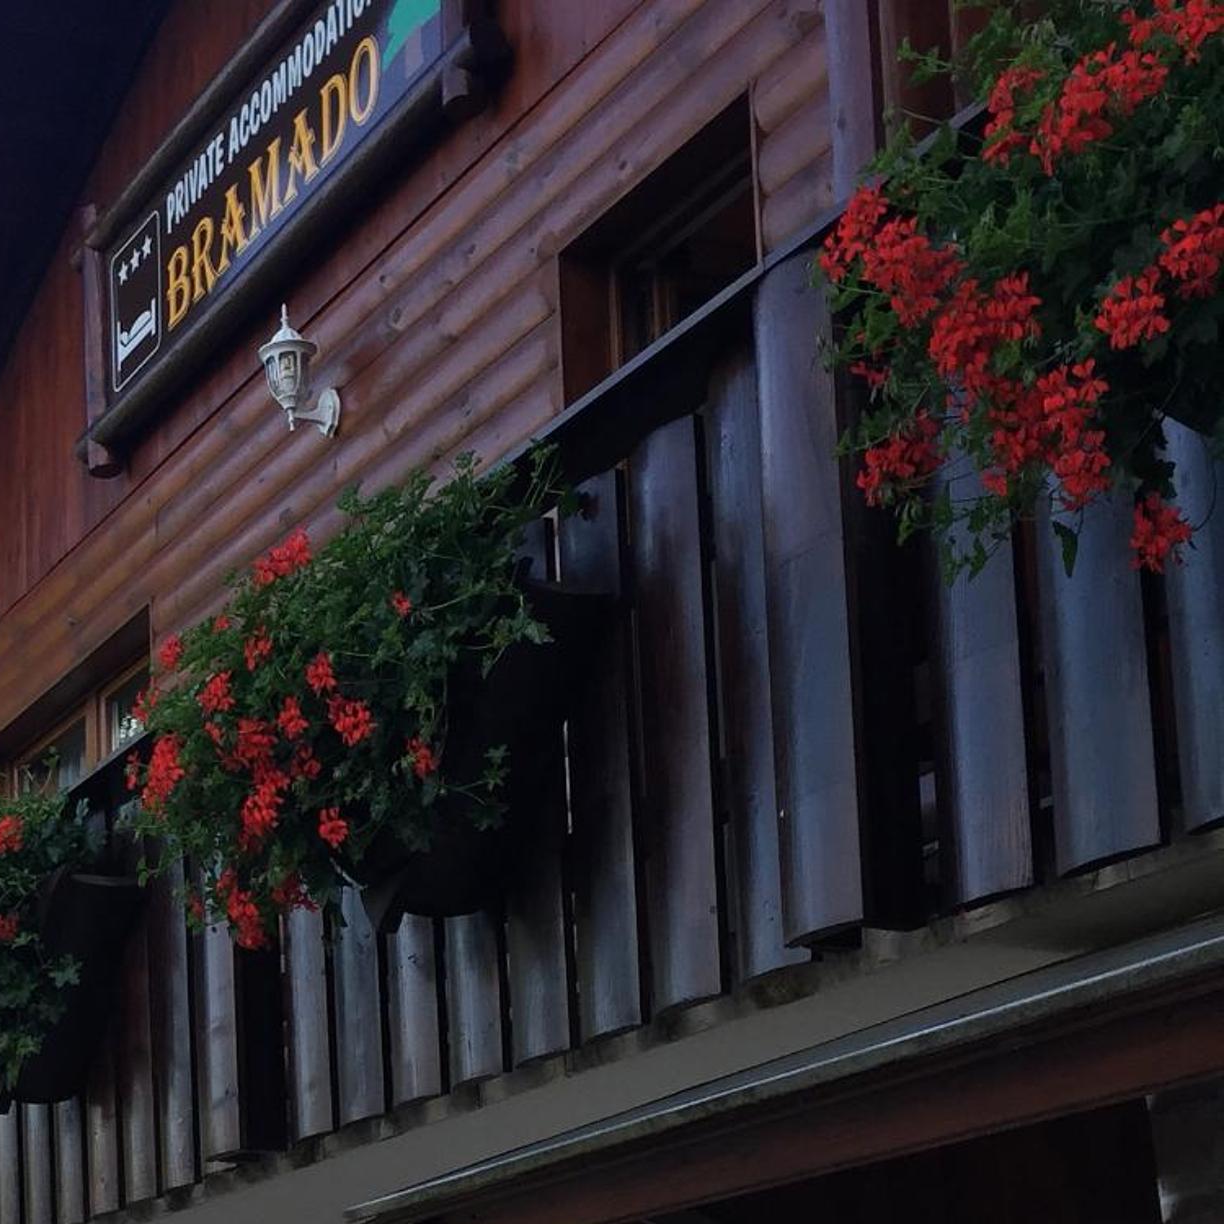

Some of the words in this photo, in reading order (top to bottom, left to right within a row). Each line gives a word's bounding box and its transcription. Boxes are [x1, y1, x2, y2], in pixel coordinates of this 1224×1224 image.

[166, 131, 225, 234] PRIVATE
[228, 0, 372, 164] ACCOMMODATI
[166, 34, 381, 332] BRAMADO
